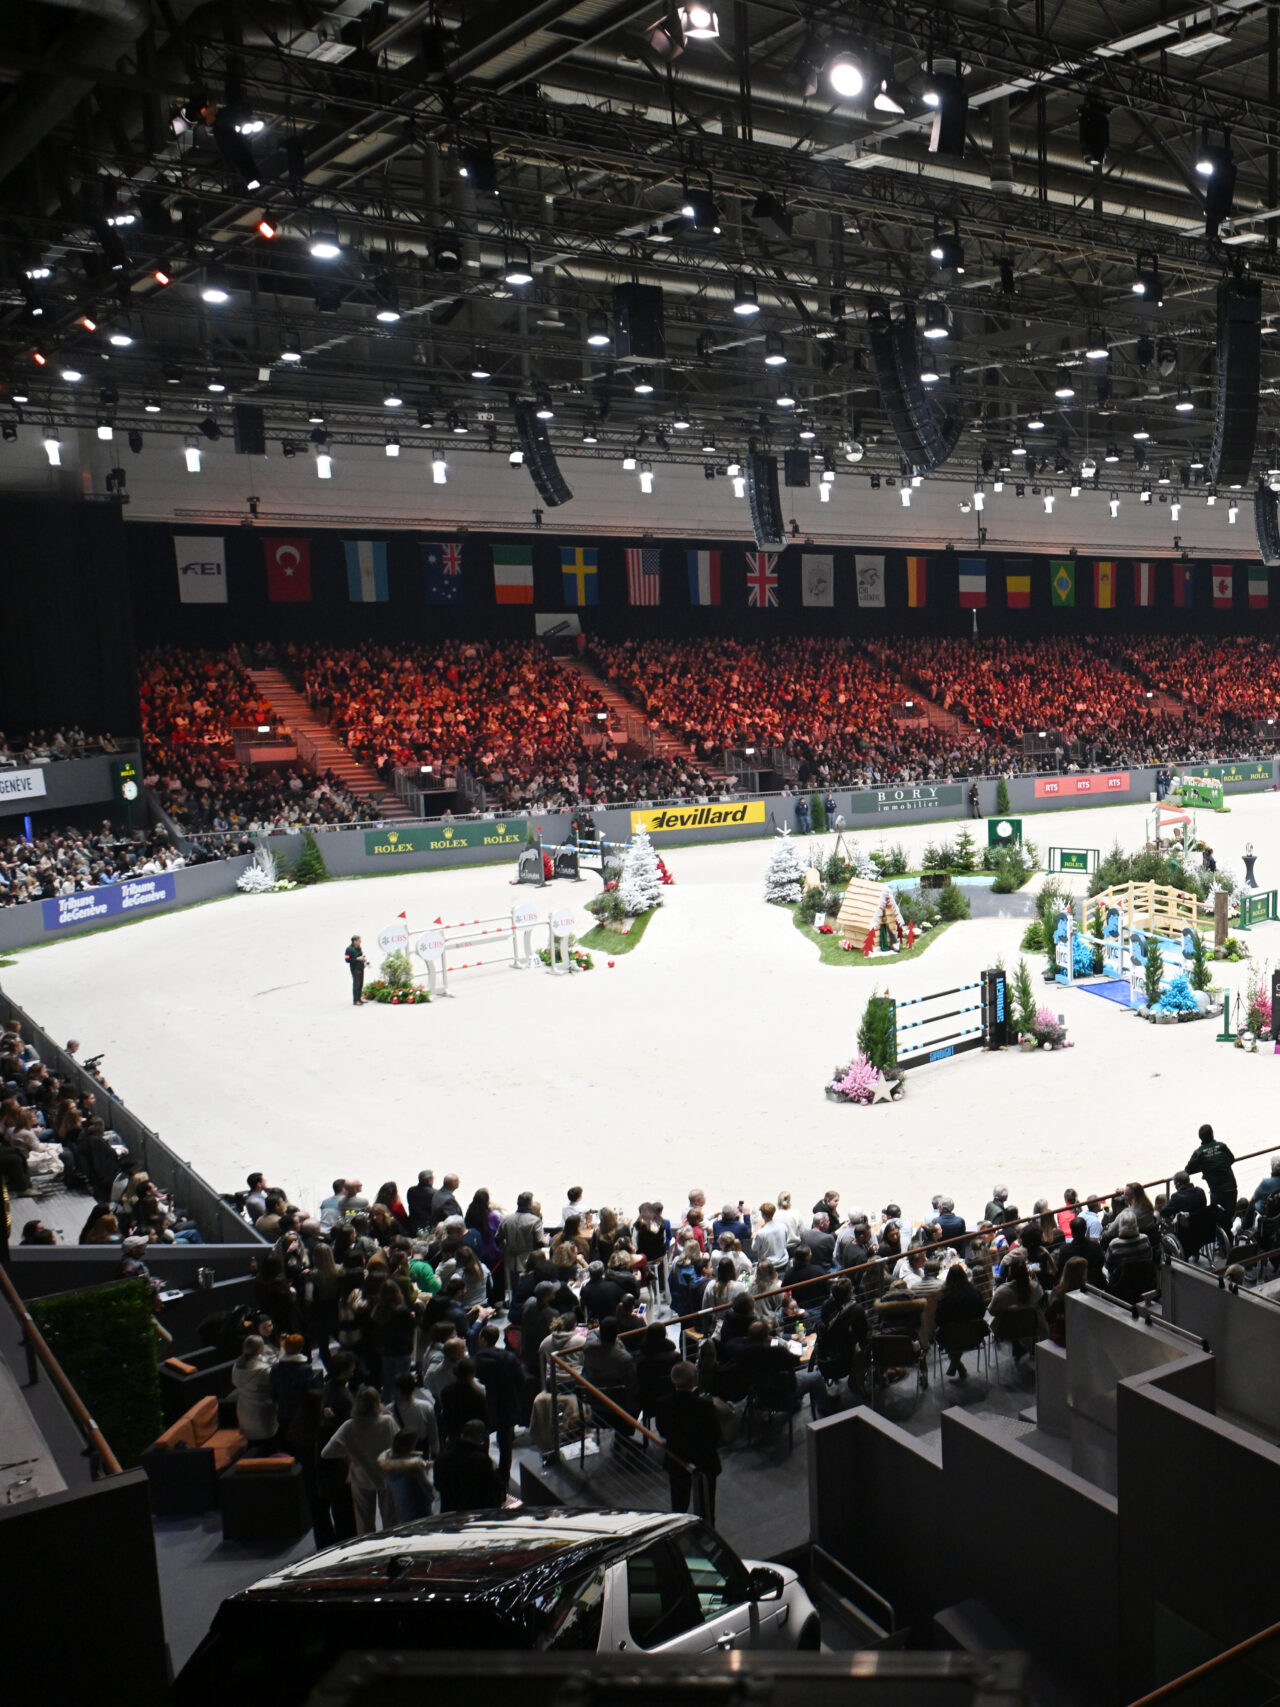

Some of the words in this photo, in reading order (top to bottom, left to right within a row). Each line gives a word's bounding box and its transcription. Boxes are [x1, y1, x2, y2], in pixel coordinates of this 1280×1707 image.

[1045, 784, 1058, 792] RTS
[1077, 781, 1090, 789] RTS
[1108, 779, 1121, 787] RTS
[878, 787, 939, 801] BORY
[878, 801, 939, 811] immobilier
[652, 805, 747, 828] devillard
[430, 839, 468, 849] ROLEX
[483, 834, 520, 845] ROLEX
[374, 844, 413, 854] ROLEX
[121, 881, 155, 897] Tribune
[58, 895, 95, 911] Tribune
[122, 890, 166, 908] deGenève
[59, 904, 107, 923] deGenève
[523, 913, 538, 921] UBS
[560, 918, 575, 927] UBS
[391, 935, 407, 943] UBS
[428, 941, 444, 949] UBS
